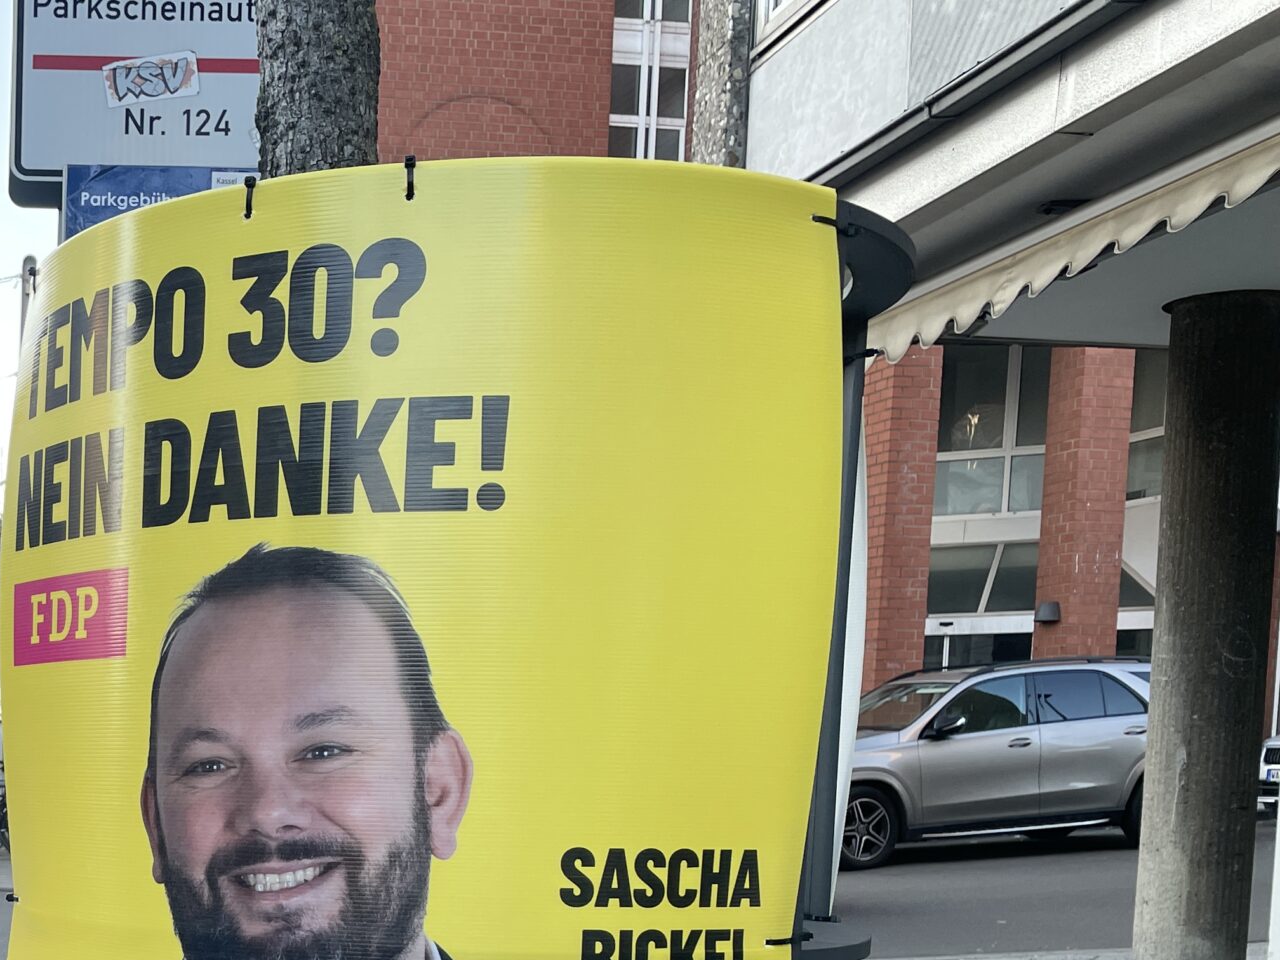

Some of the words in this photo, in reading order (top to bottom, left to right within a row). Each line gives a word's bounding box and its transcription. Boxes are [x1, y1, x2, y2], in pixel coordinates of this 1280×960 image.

[112, 57, 189, 102] KSV
[124, 108, 165, 135] Nr.
[182, 109, 231, 136] 124
[80, 191, 179, 210] Parkgebüh
[216, 177, 237, 185] Kassel
[26, 265, 207, 420] TEMPO
[227, 237, 427, 369] 30?
[15, 427, 125, 552] NEIN
[142, 395, 510, 529] DANKE!
[29, 585, 100, 646] FDP
[559, 846, 761, 908] SASCHA
